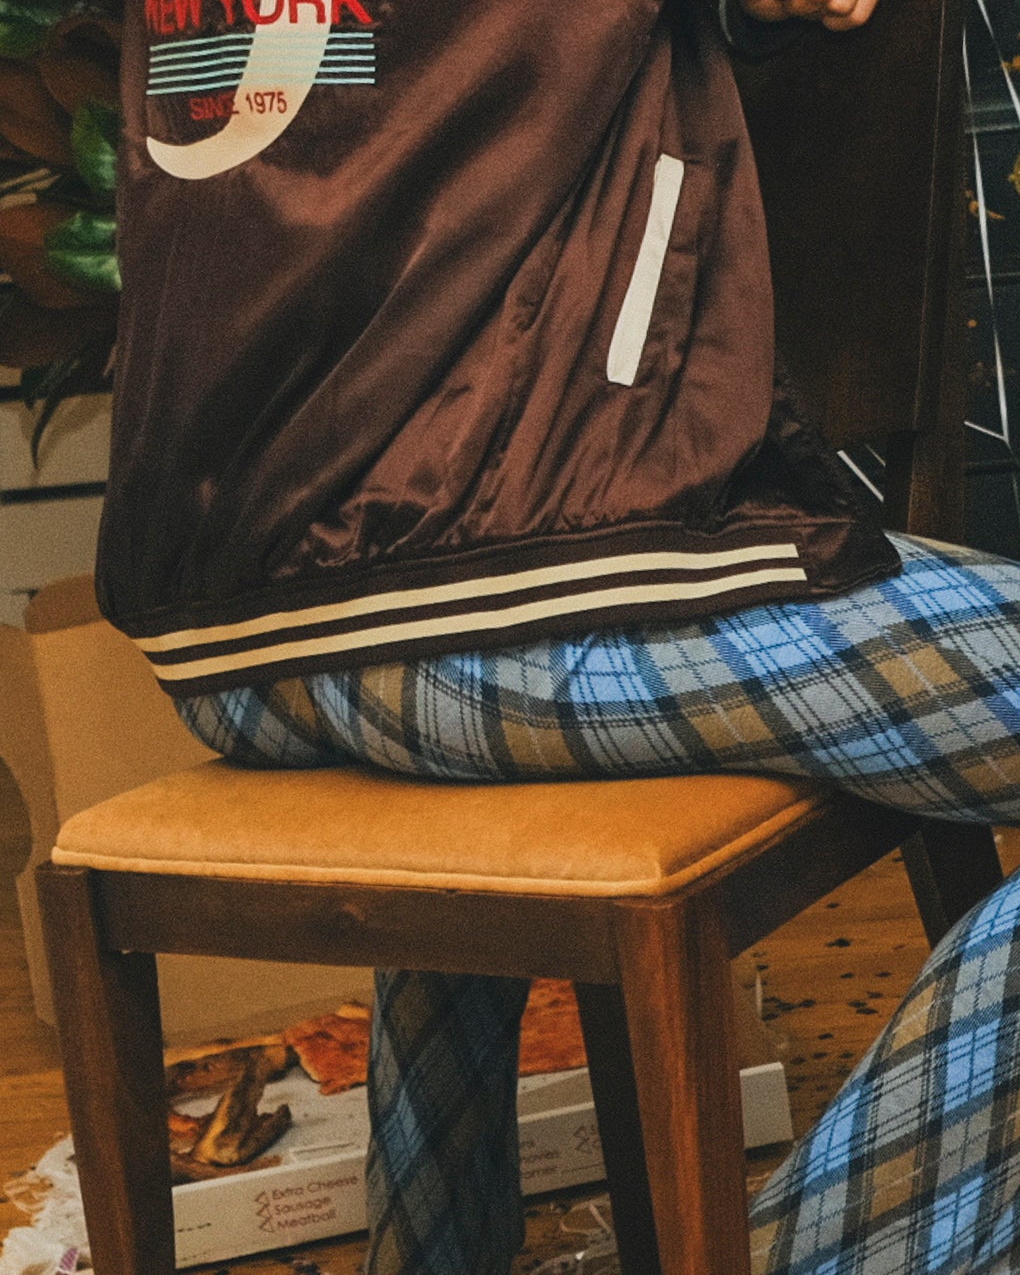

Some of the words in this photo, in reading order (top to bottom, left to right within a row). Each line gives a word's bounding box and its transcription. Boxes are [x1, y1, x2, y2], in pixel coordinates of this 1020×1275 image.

[245, 90, 288, 115] 1975
[274, 1196, 332, 1216] Sausage
[277, 1208, 337, 1230] Meatball
